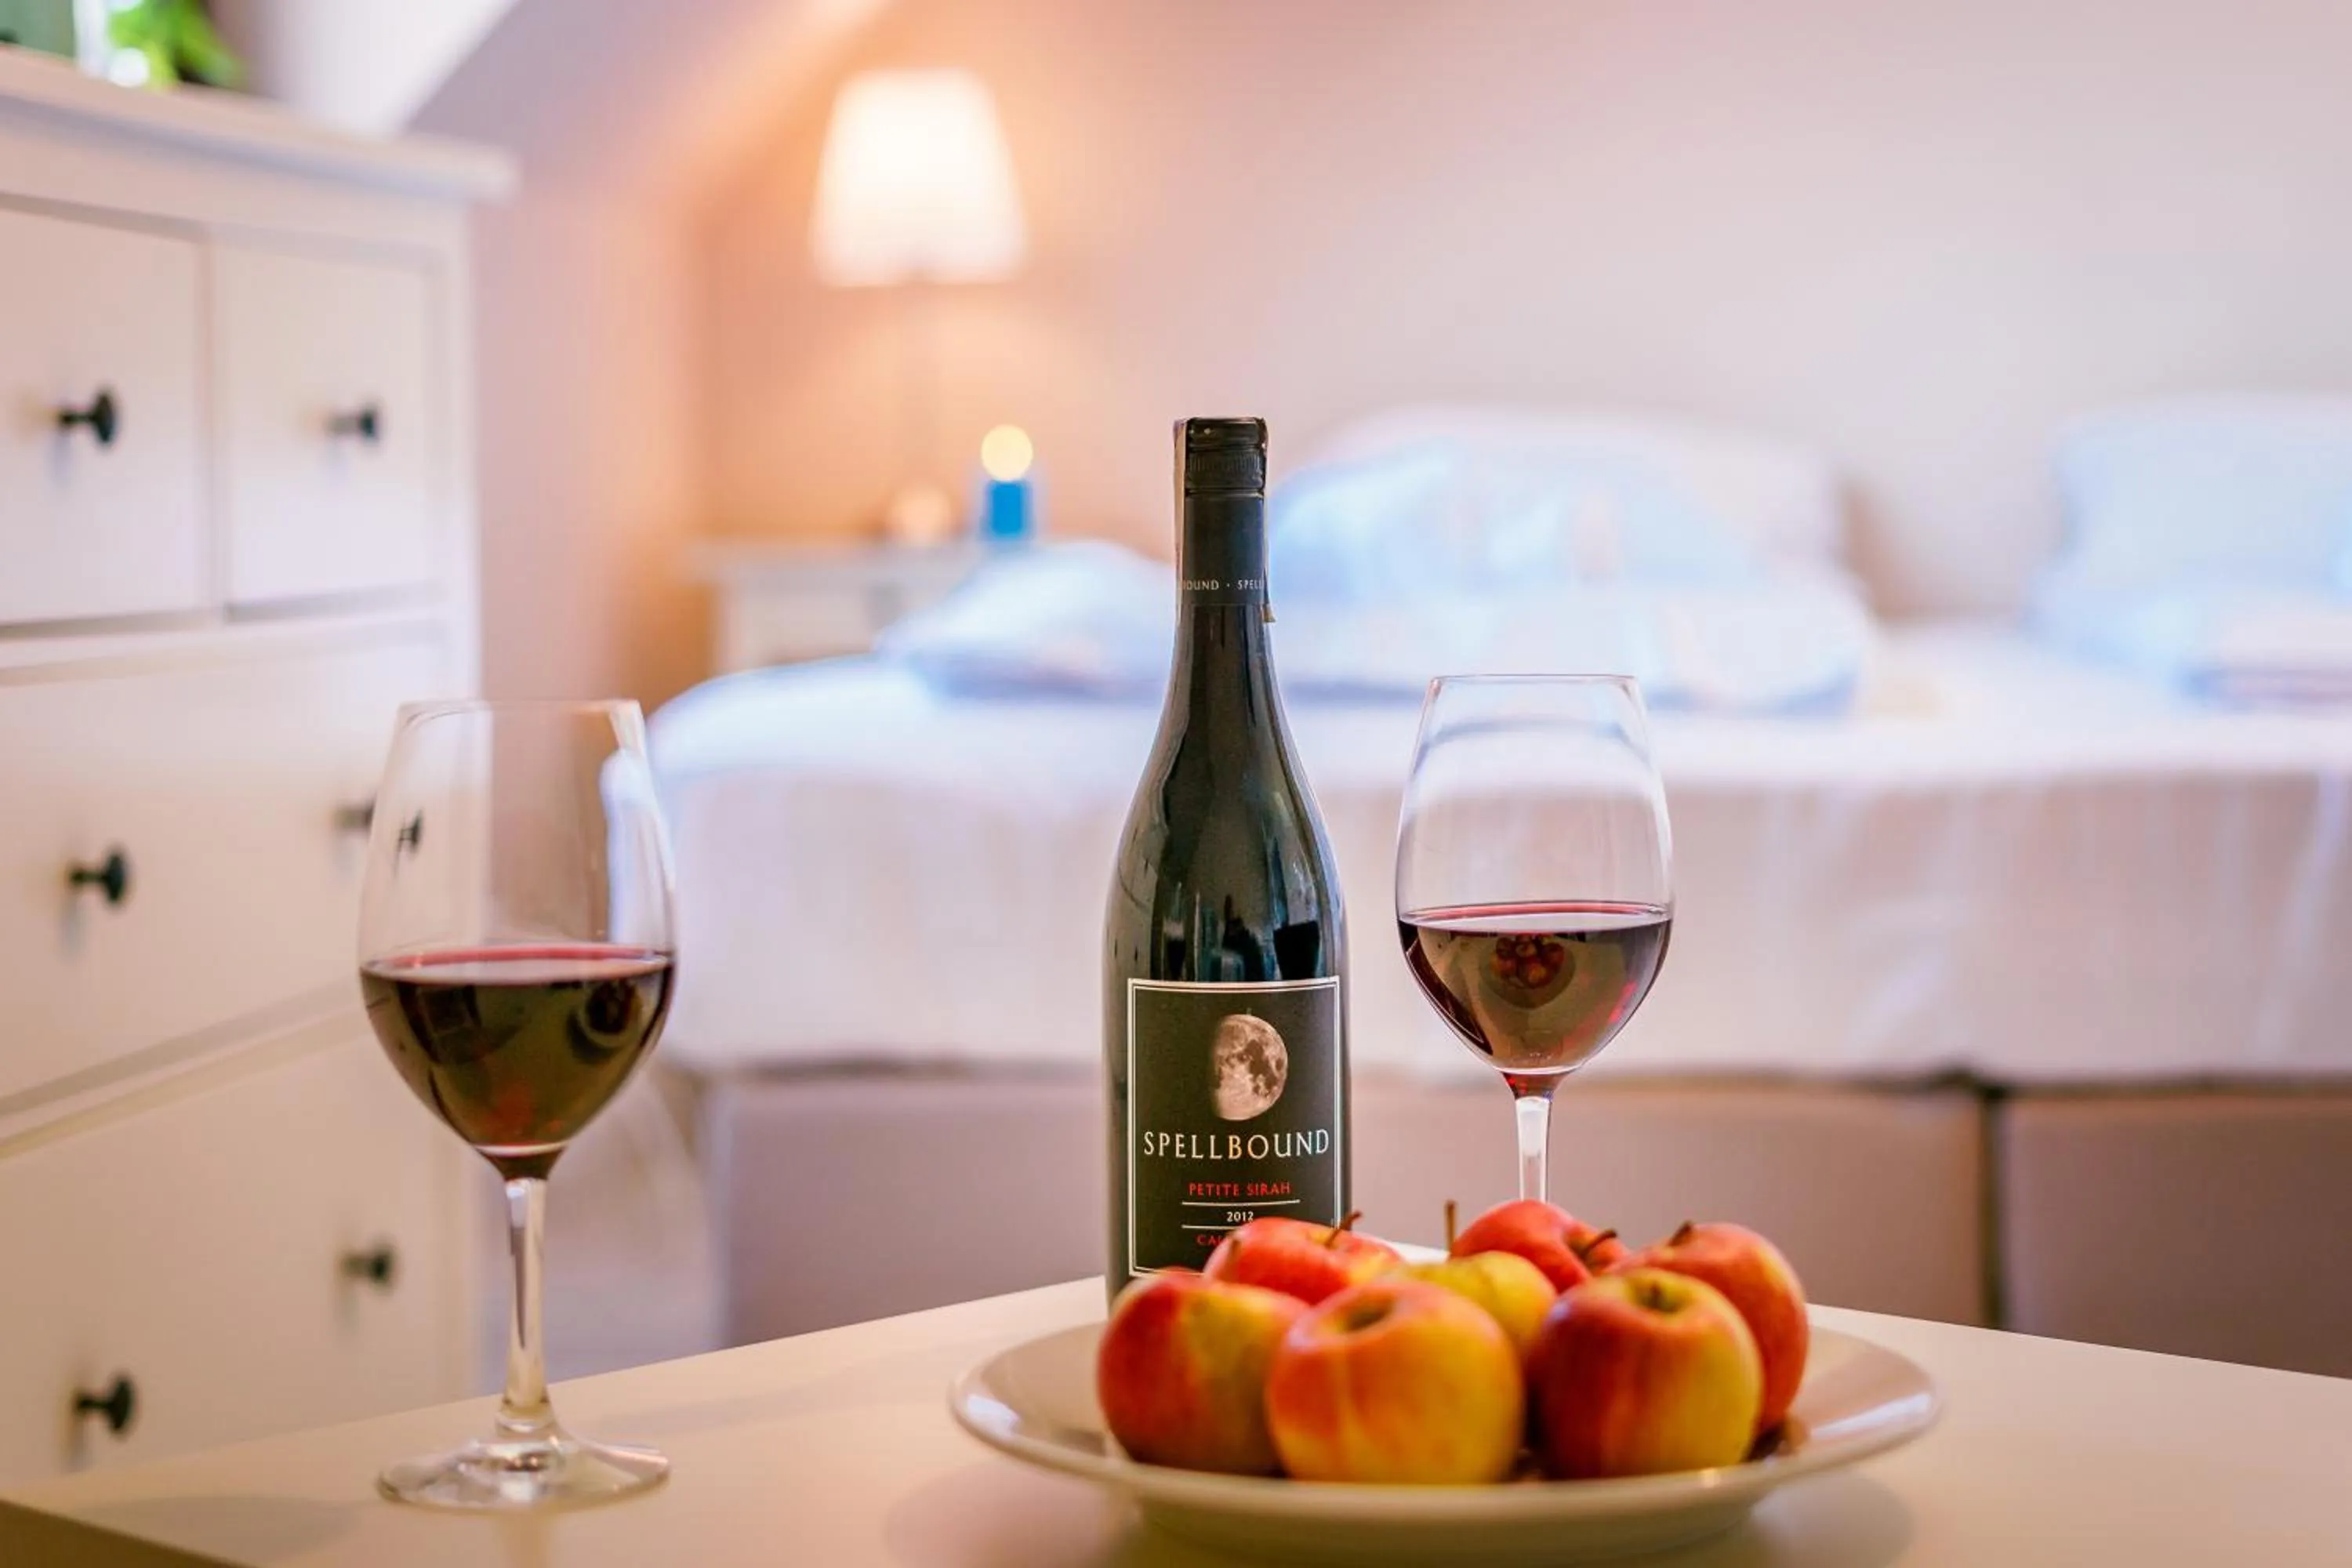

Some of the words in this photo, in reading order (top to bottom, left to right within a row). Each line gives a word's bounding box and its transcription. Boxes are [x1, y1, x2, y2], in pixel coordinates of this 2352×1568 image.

[1143, 1128, 1330, 1160] SPELLBOUND
[1189, 1182, 1240, 1196] PETITE
[1246, 1181, 1292, 1196] SIRAH
[1226, 1210, 1254, 1222] 2012
